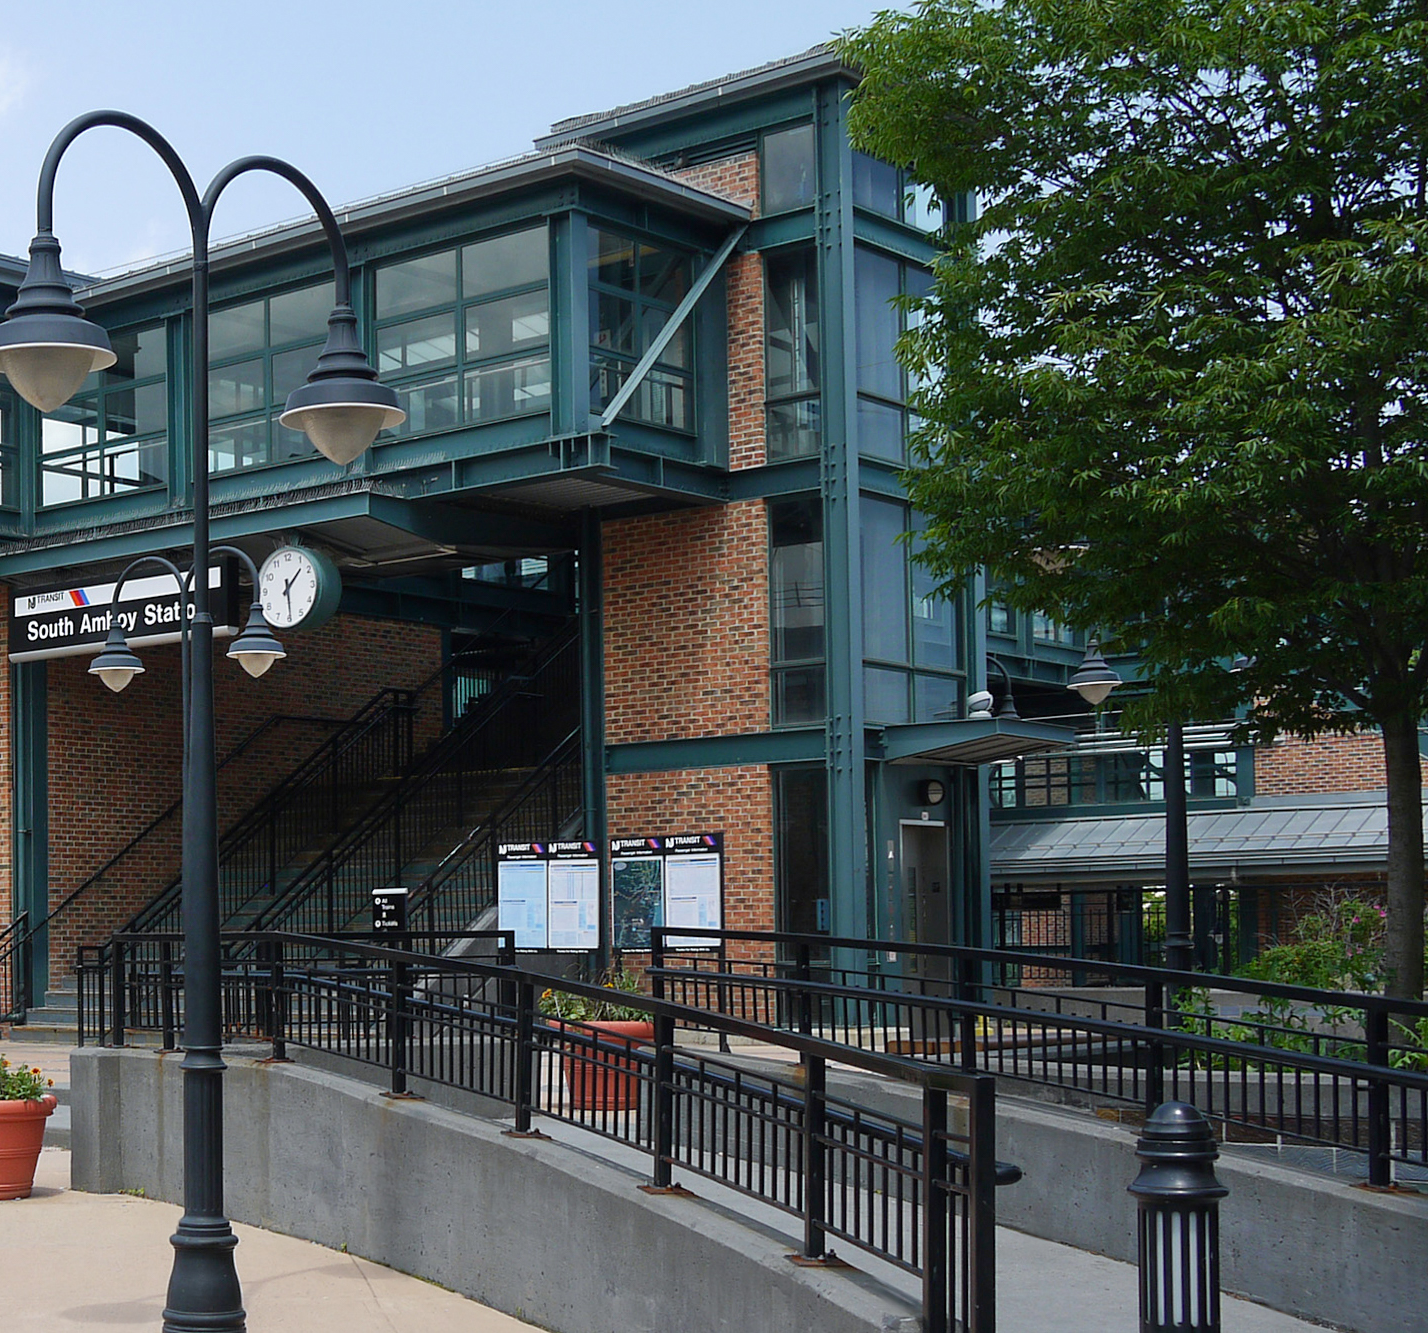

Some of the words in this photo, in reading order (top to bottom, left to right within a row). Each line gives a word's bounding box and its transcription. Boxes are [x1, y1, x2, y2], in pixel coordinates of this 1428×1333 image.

[284, 553, 292, 562] 12
[299, 556, 302, 564] 1
[274, 560, 280, 568] 11
[306, 565, 311, 573] 2
[266, 573, 274, 581] 10
[310, 580, 315, 588] 3
[263, 588, 268, 596] 9
[28, 596, 36, 610] NJ
[37, 592, 65, 604] TRANSIT
[299, 609, 304, 617] 5
[27, 616, 74, 641] South
[79, 610, 138, 634] Amboy
[144, 601, 196, 626] Stato
[620, 838, 646, 848] TRANSIT
[675, 836, 701, 845] TRANSIT
[507, 843, 531, 851] TRANSIT
[557, 842, 582, 850] TRANSIT
